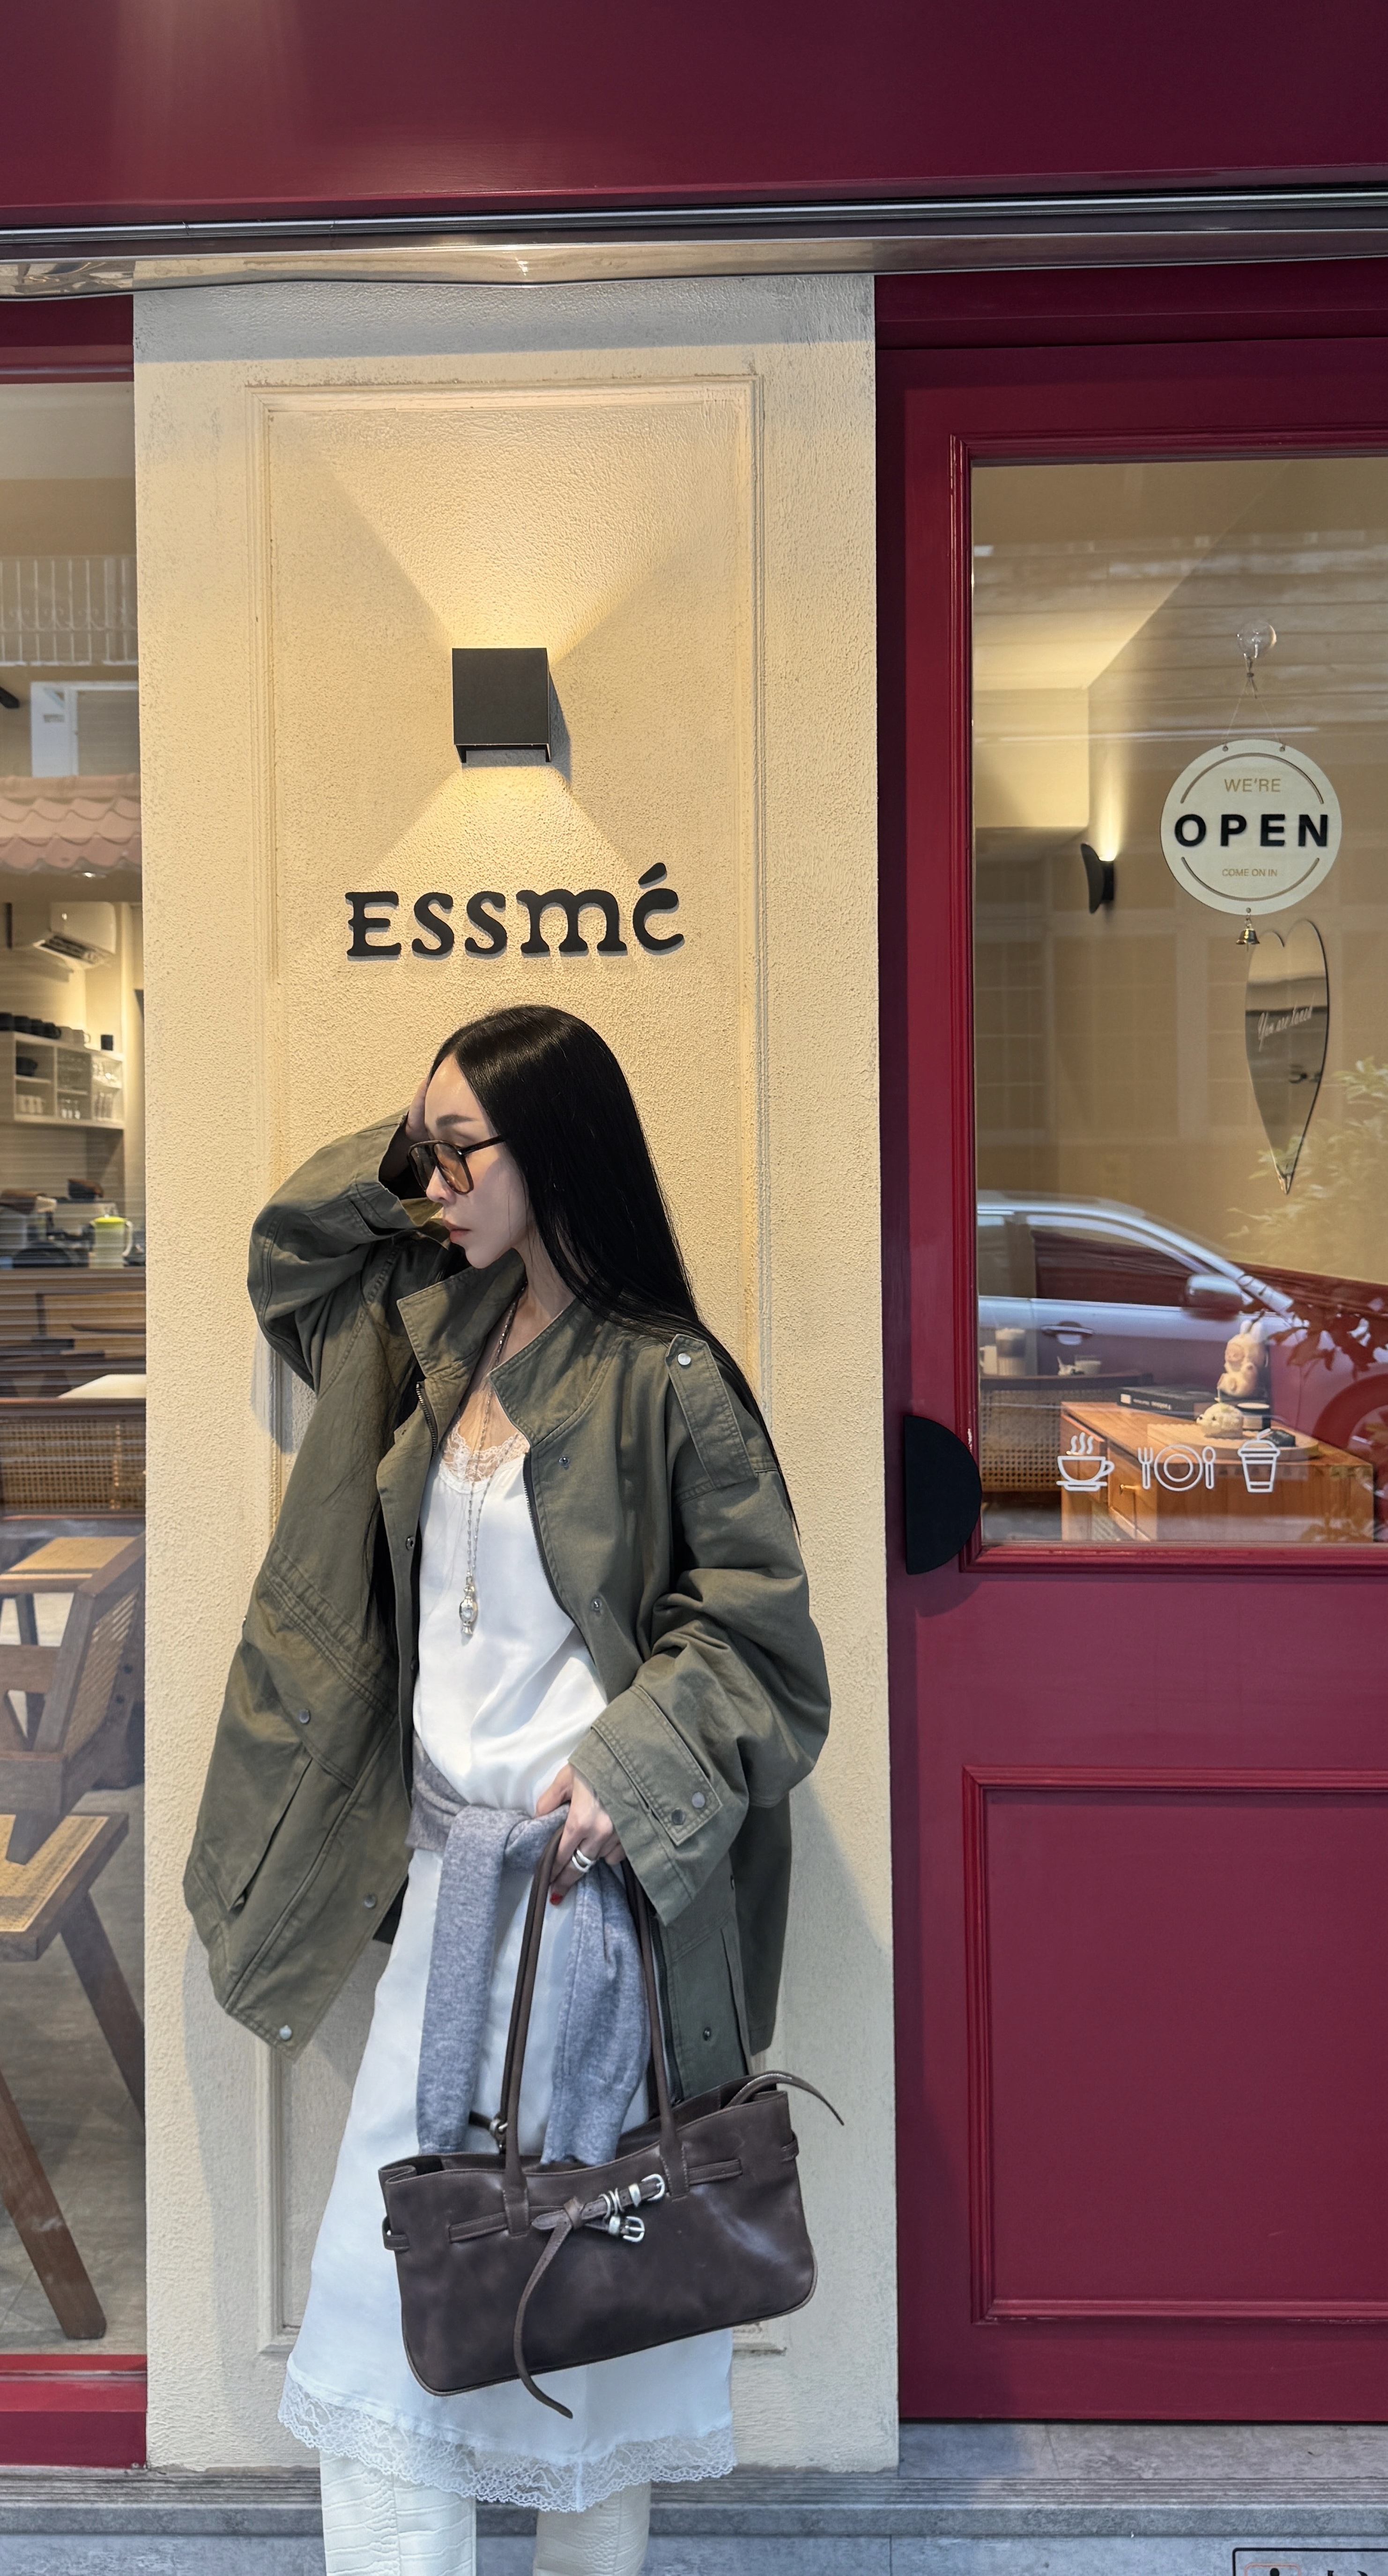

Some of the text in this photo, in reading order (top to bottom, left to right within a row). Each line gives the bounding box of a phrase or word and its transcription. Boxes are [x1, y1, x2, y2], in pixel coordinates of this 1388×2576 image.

[1224, 778, 1281, 793] WE'RE
[1174, 813, 1329, 848] OPEN
[1222, 868, 1278, 877] COME ON IN
